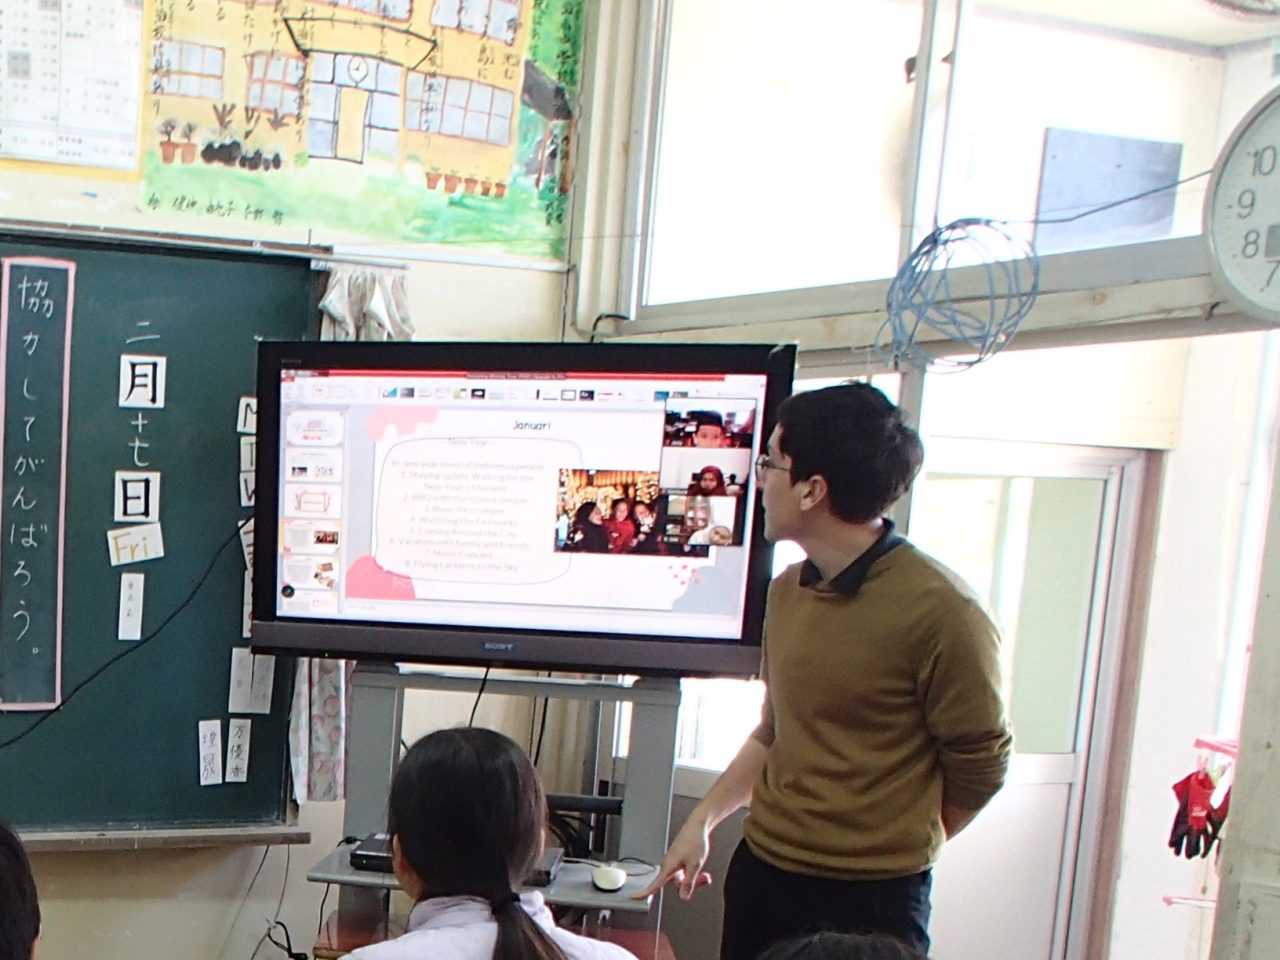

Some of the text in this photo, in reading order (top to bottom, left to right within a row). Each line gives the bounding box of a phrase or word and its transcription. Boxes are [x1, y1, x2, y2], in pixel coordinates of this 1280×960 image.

[1252, 145, 1277, 176] 10
[1237, 188, 1256, 219] 9
[1242, 229, 1260, 259] 8
[11, 275, 54, 655] 協力してがんばろう。
